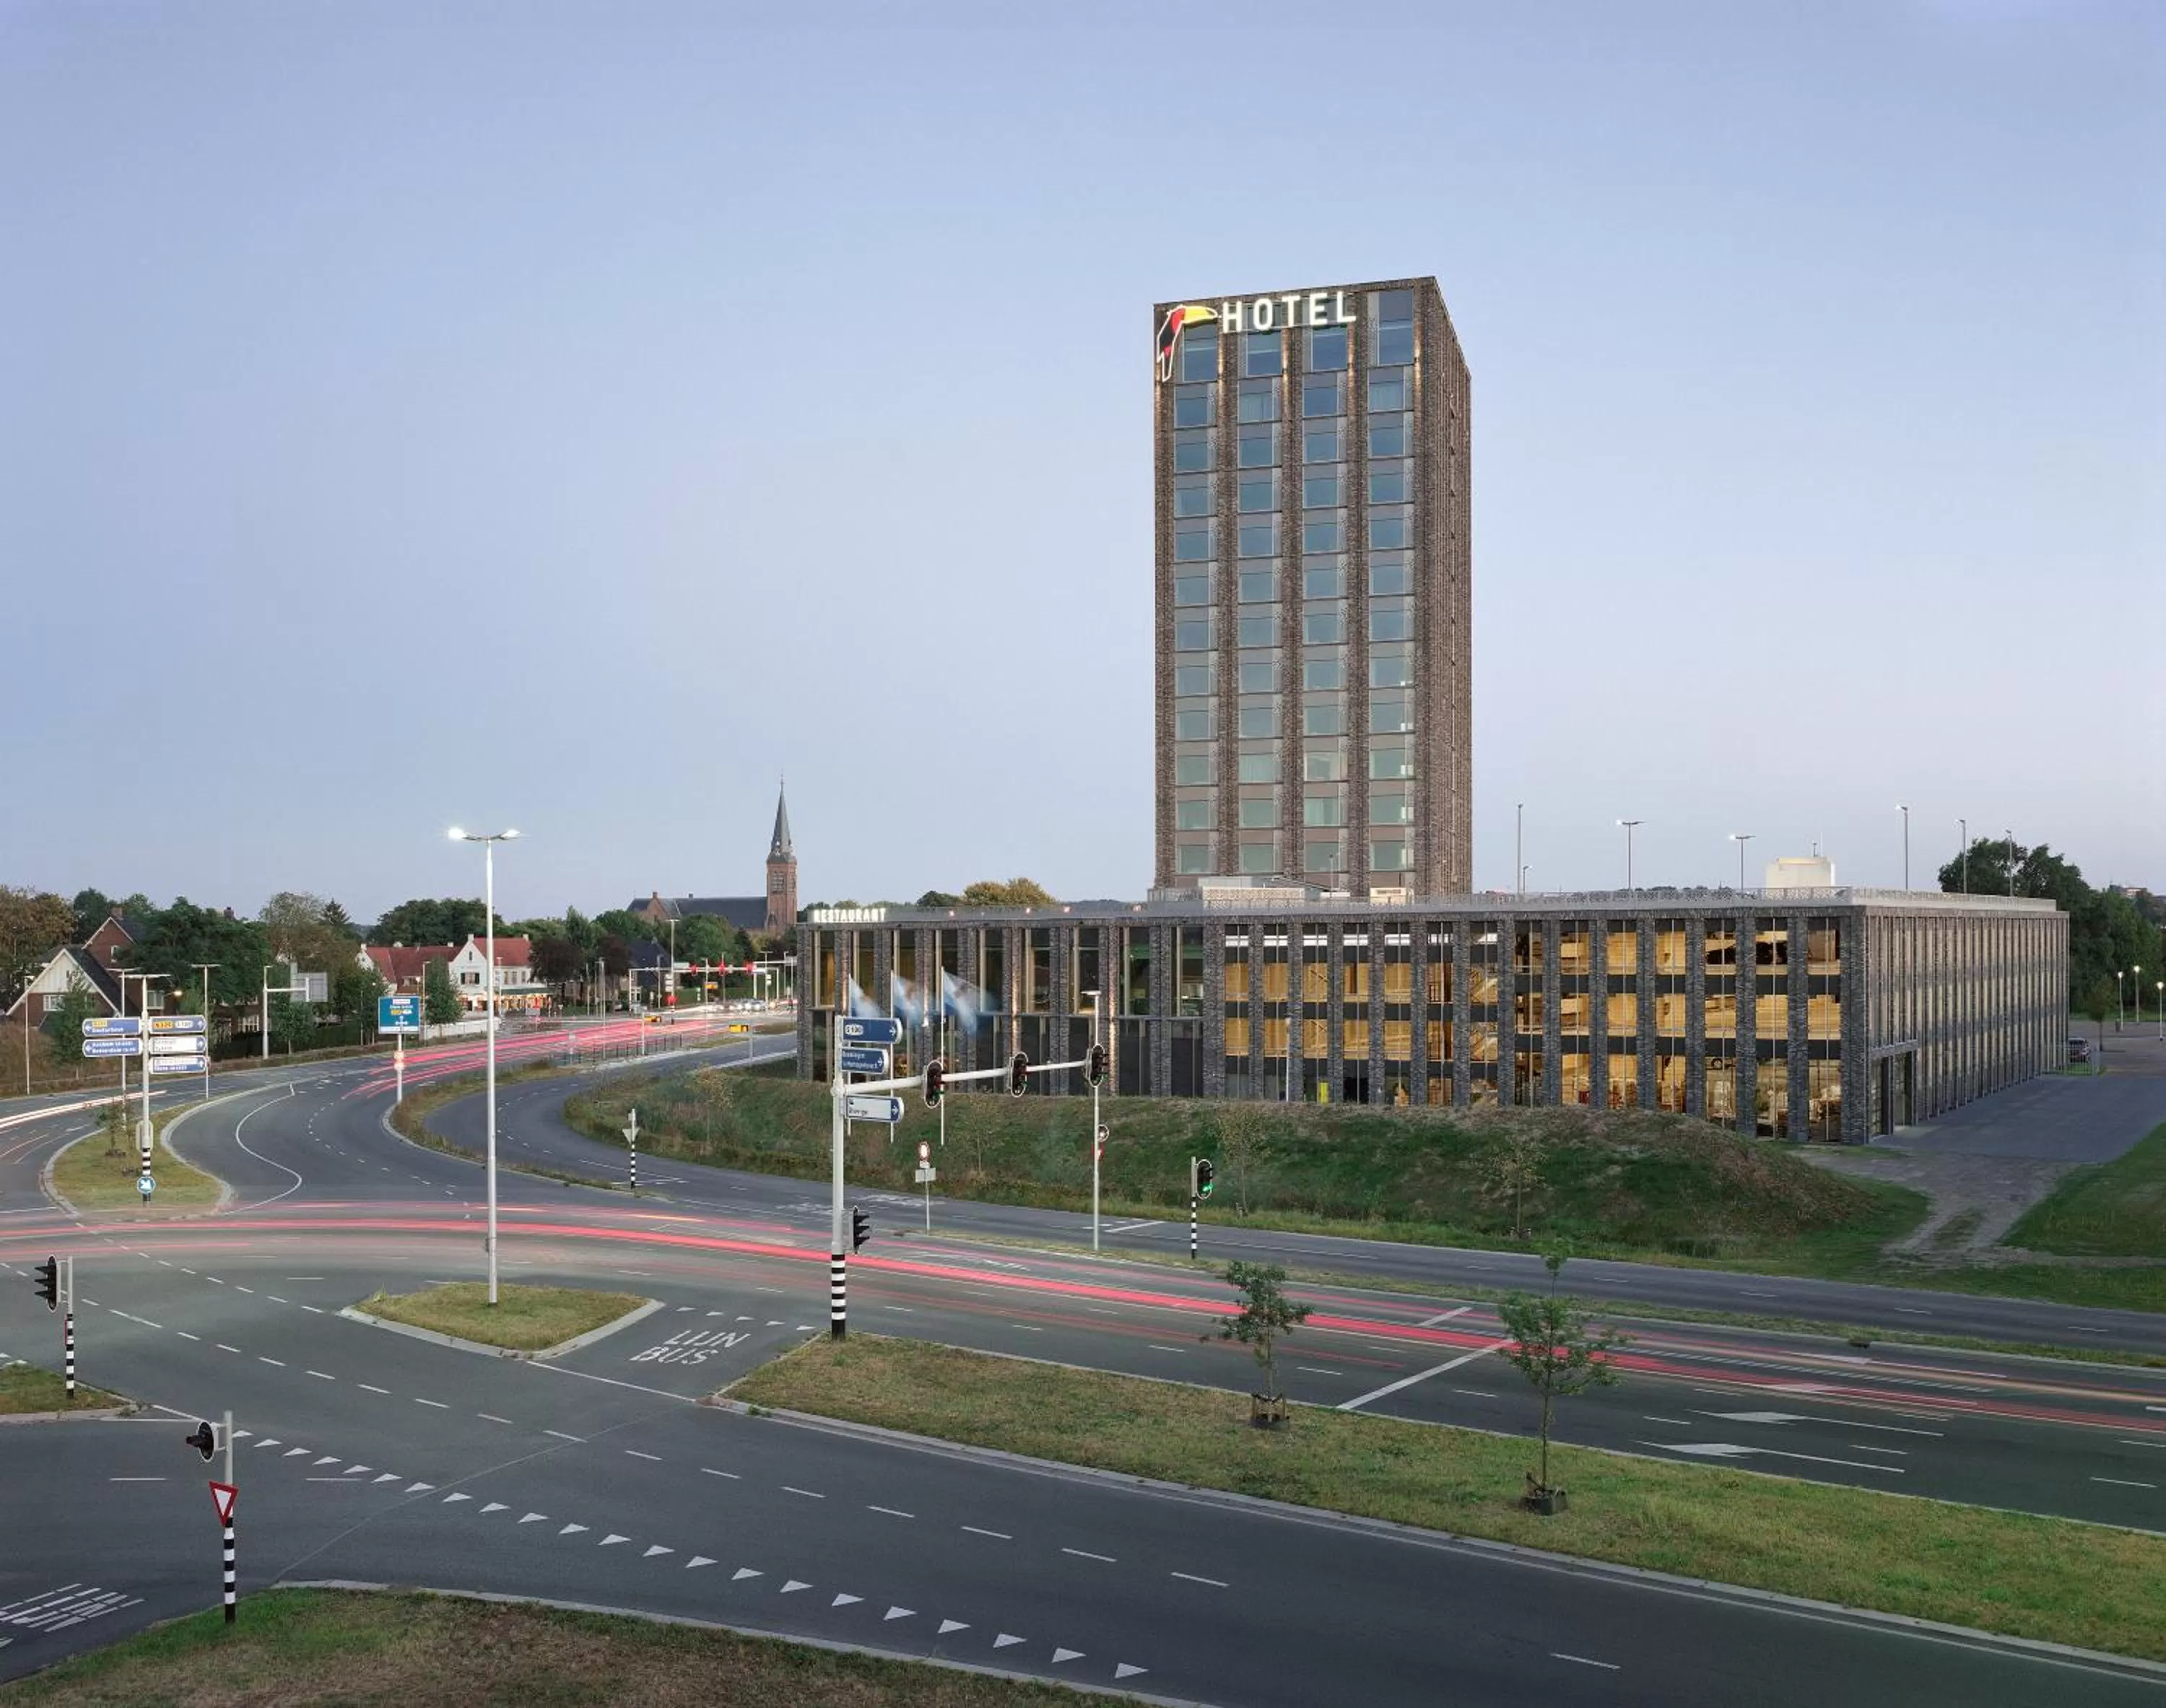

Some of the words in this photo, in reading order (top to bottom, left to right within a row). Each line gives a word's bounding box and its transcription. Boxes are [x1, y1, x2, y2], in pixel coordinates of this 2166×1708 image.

[1222, 291, 1357, 334] HOTEL
[813, 907, 887, 923] RESTAURANT
[662, 1329, 752, 1348] LIJN
[627, 1346, 719, 1365] BUS
